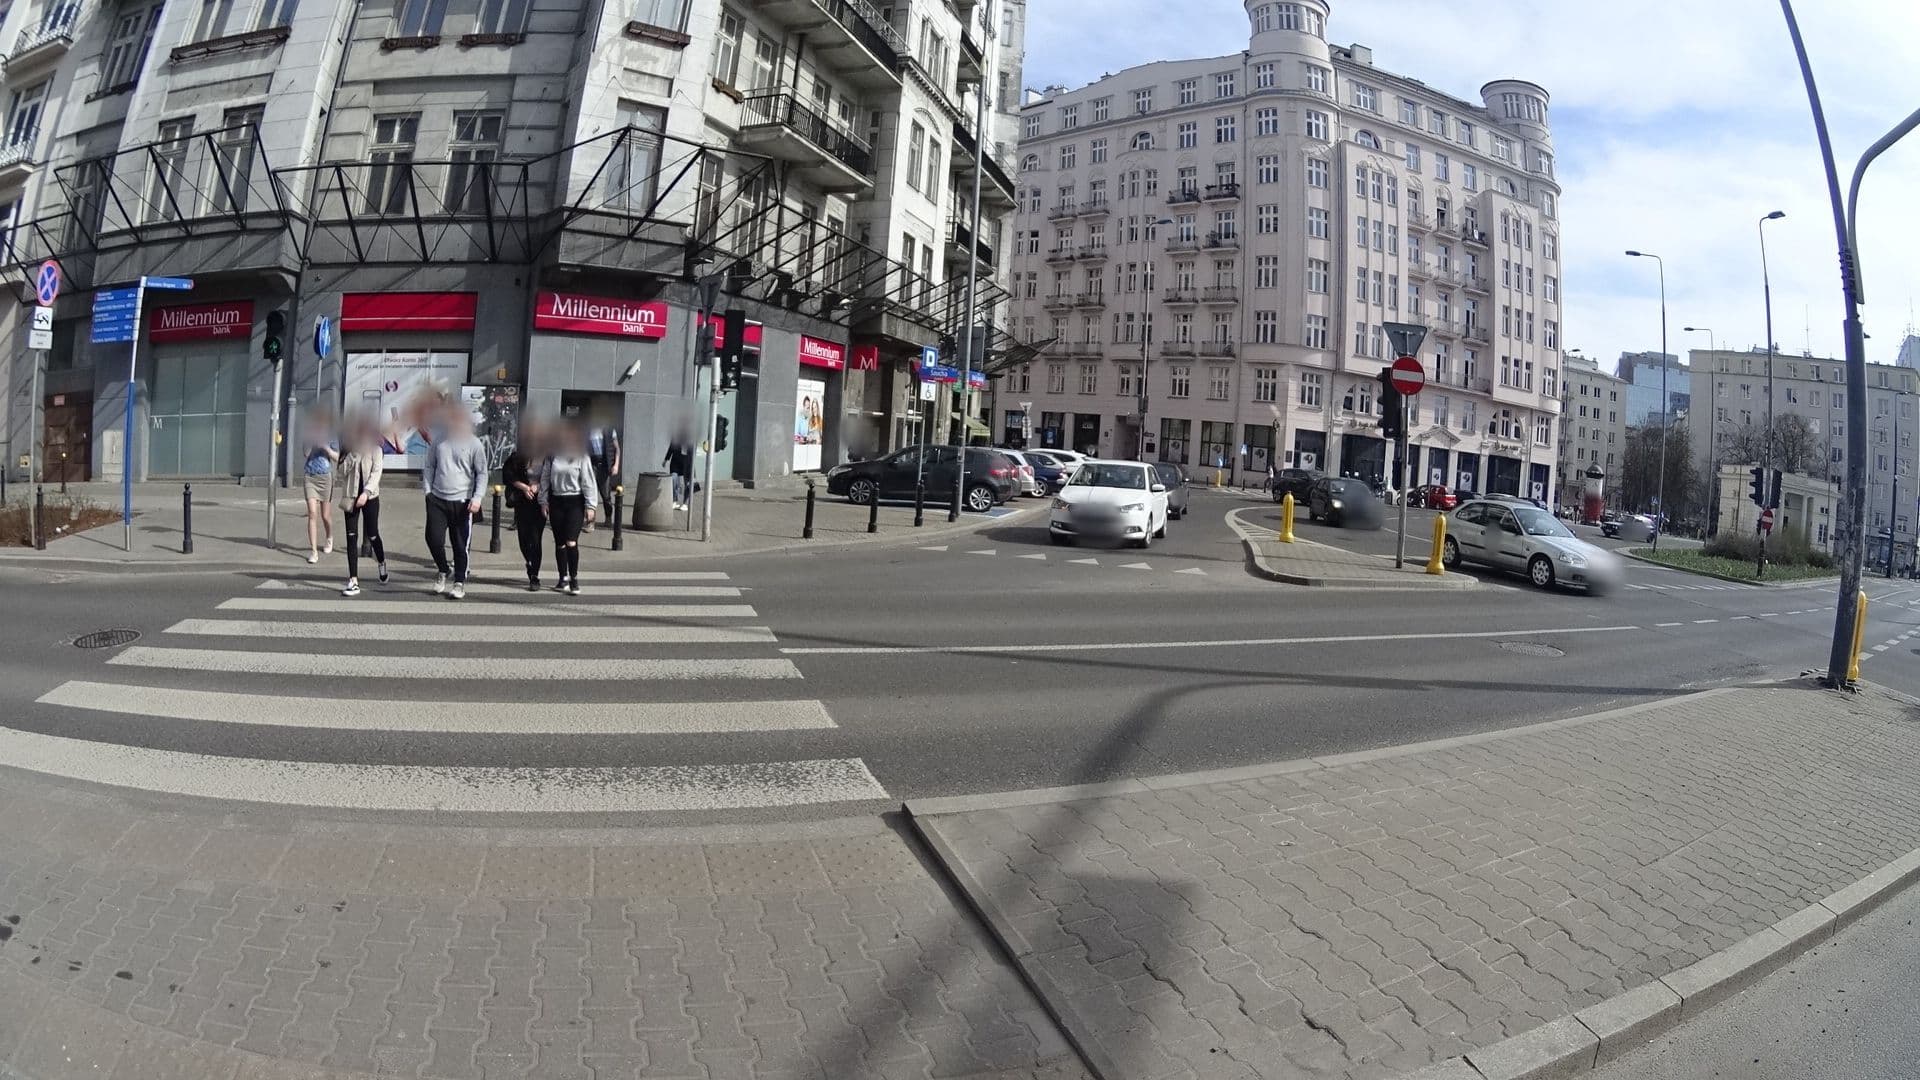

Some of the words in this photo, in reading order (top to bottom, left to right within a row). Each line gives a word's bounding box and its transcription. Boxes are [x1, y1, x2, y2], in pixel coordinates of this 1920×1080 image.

[161, 308, 240, 329] Millennium
[553, 293, 655, 324] Millennium
[212, 324, 231, 335] bank
[622, 323, 645, 334] bank
[804, 337, 840, 359] Millennium
